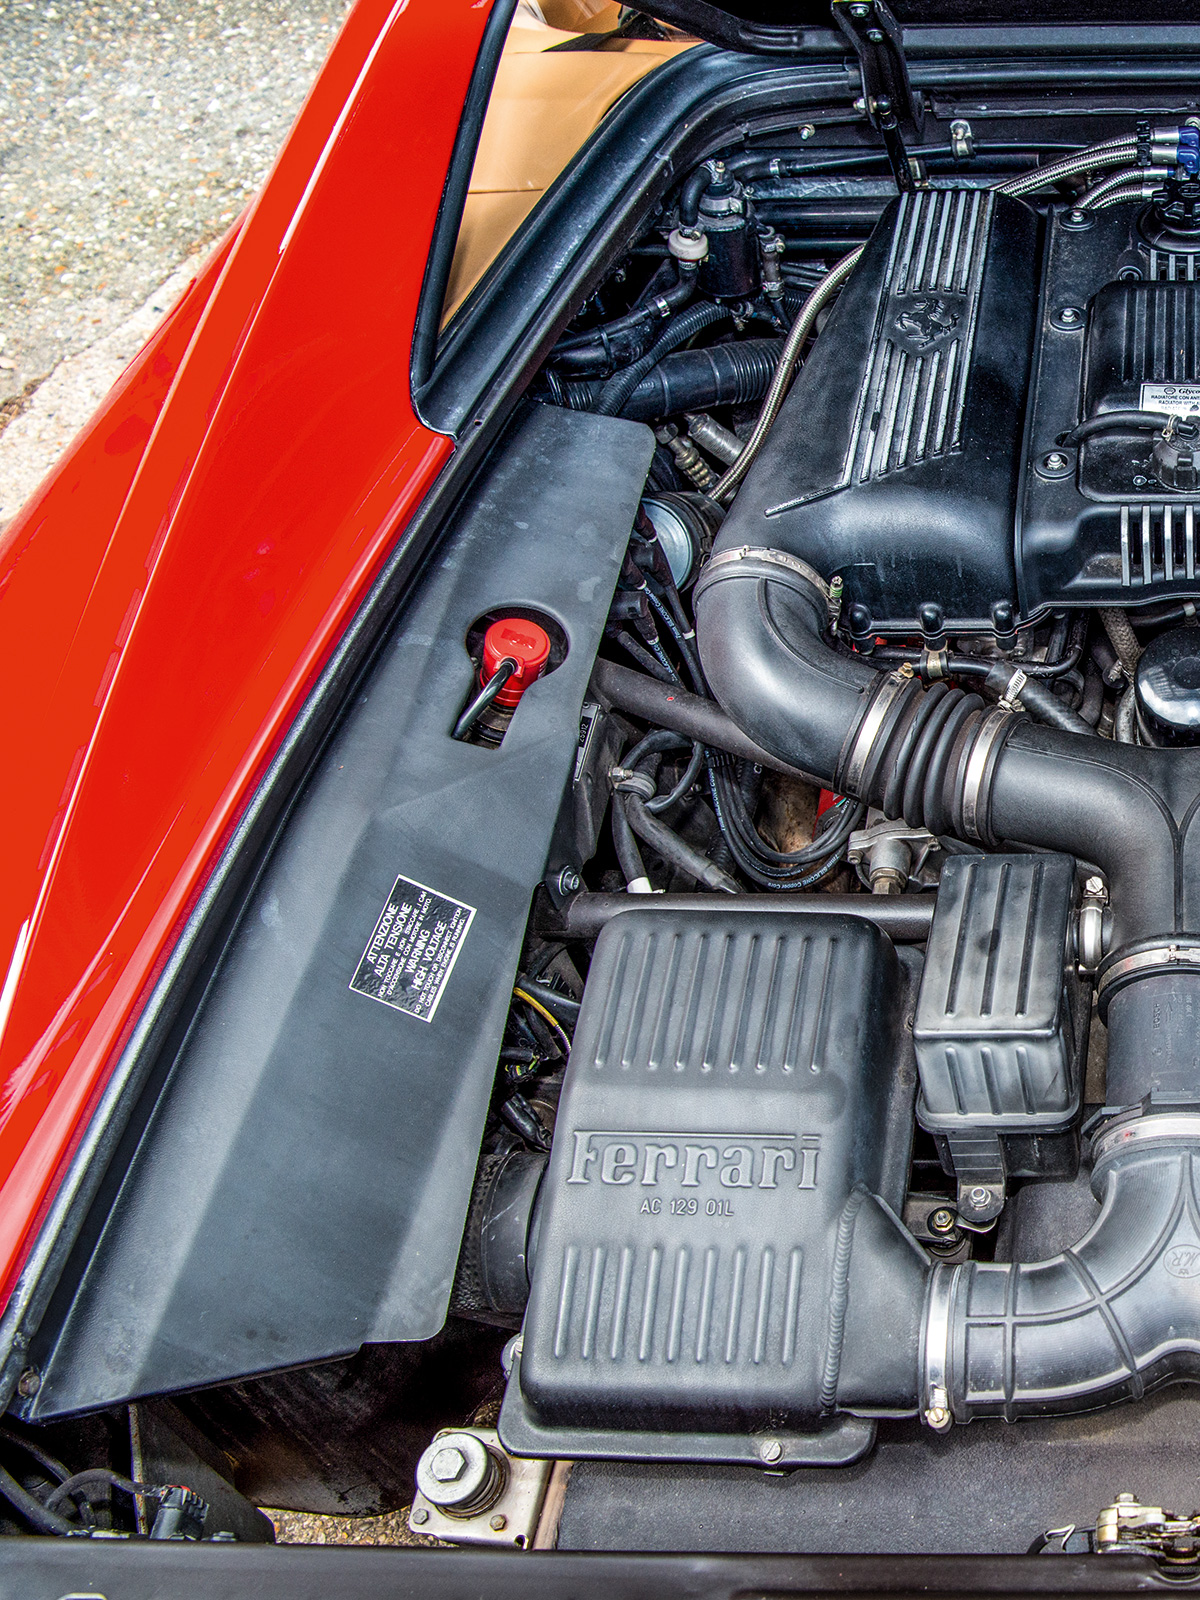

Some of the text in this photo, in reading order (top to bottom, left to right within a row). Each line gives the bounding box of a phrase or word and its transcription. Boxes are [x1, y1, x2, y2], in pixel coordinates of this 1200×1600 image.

[365, 902, 398, 964] ATTENZIONE
[373, 901, 412, 977] ALTA TENSIONE
[377, 984, 386, 997] NON
[383, 957, 398, 983] TOCCARE
[397, 937, 406, 950] NON
[404, 908, 419, 934] STACCARE
[403, 943, 412, 956] CON
[408, 920, 421, 942] MOTORE
[404, 928, 430, 974] WARNING
[410, 920, 447, 990] HIGH VOLTAGE
[414, 907, 462, 1013] DO NOT TOUCH OR DISCONNECT IGNITION
[424, 985, 437, 1006] CABLES
[433, 968, 444, 984] WHEN
[441, 948, 452, 967] ENGINE
[566, 1130, 822, 1190] Ferrari
[639, 1197, 734, 1216] AC 129 01L
